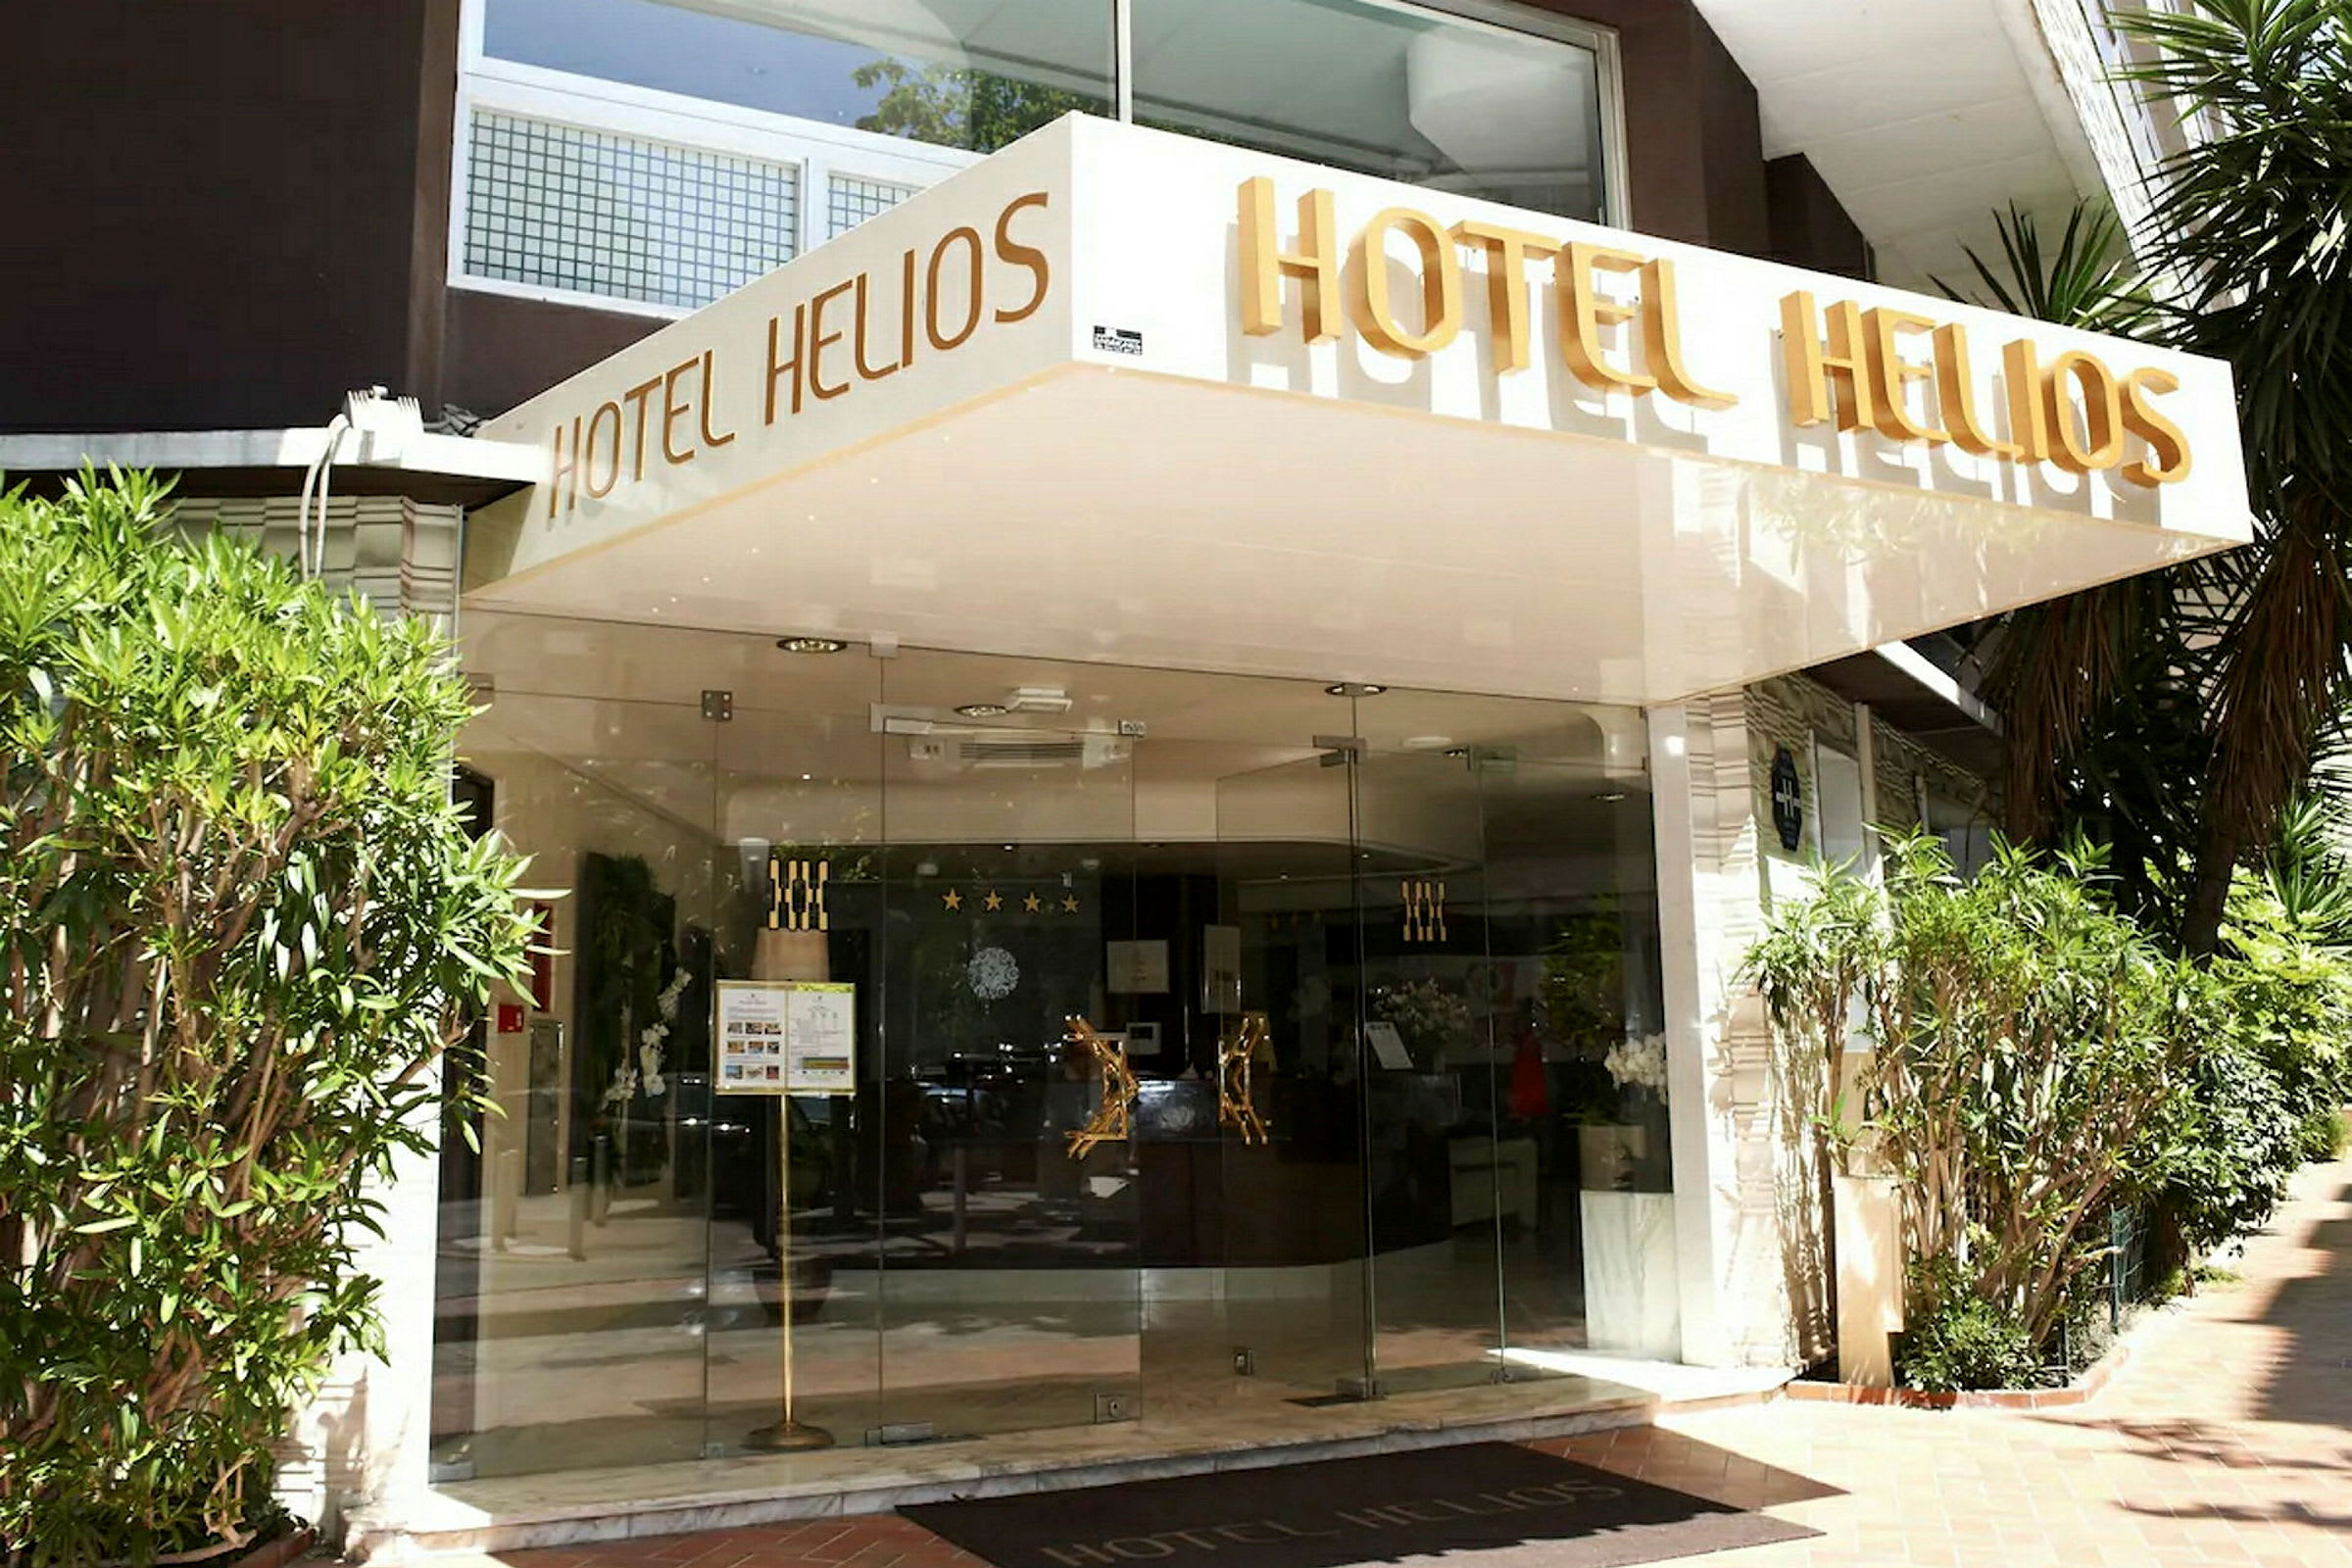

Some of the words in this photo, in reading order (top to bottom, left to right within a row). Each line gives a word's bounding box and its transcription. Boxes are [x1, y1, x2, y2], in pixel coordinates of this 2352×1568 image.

[547, 349, 735, 518] HOTEL
[764, 192, 1050, 426] HELIOS
[1237, 175, 1739, 412] HOTEL
[1779, 290, 2193, 487] HELIOS
[1039, 1520, 1340, 1567] HOTEL
[1336, 1480, 1622, 1530] HELIOS
